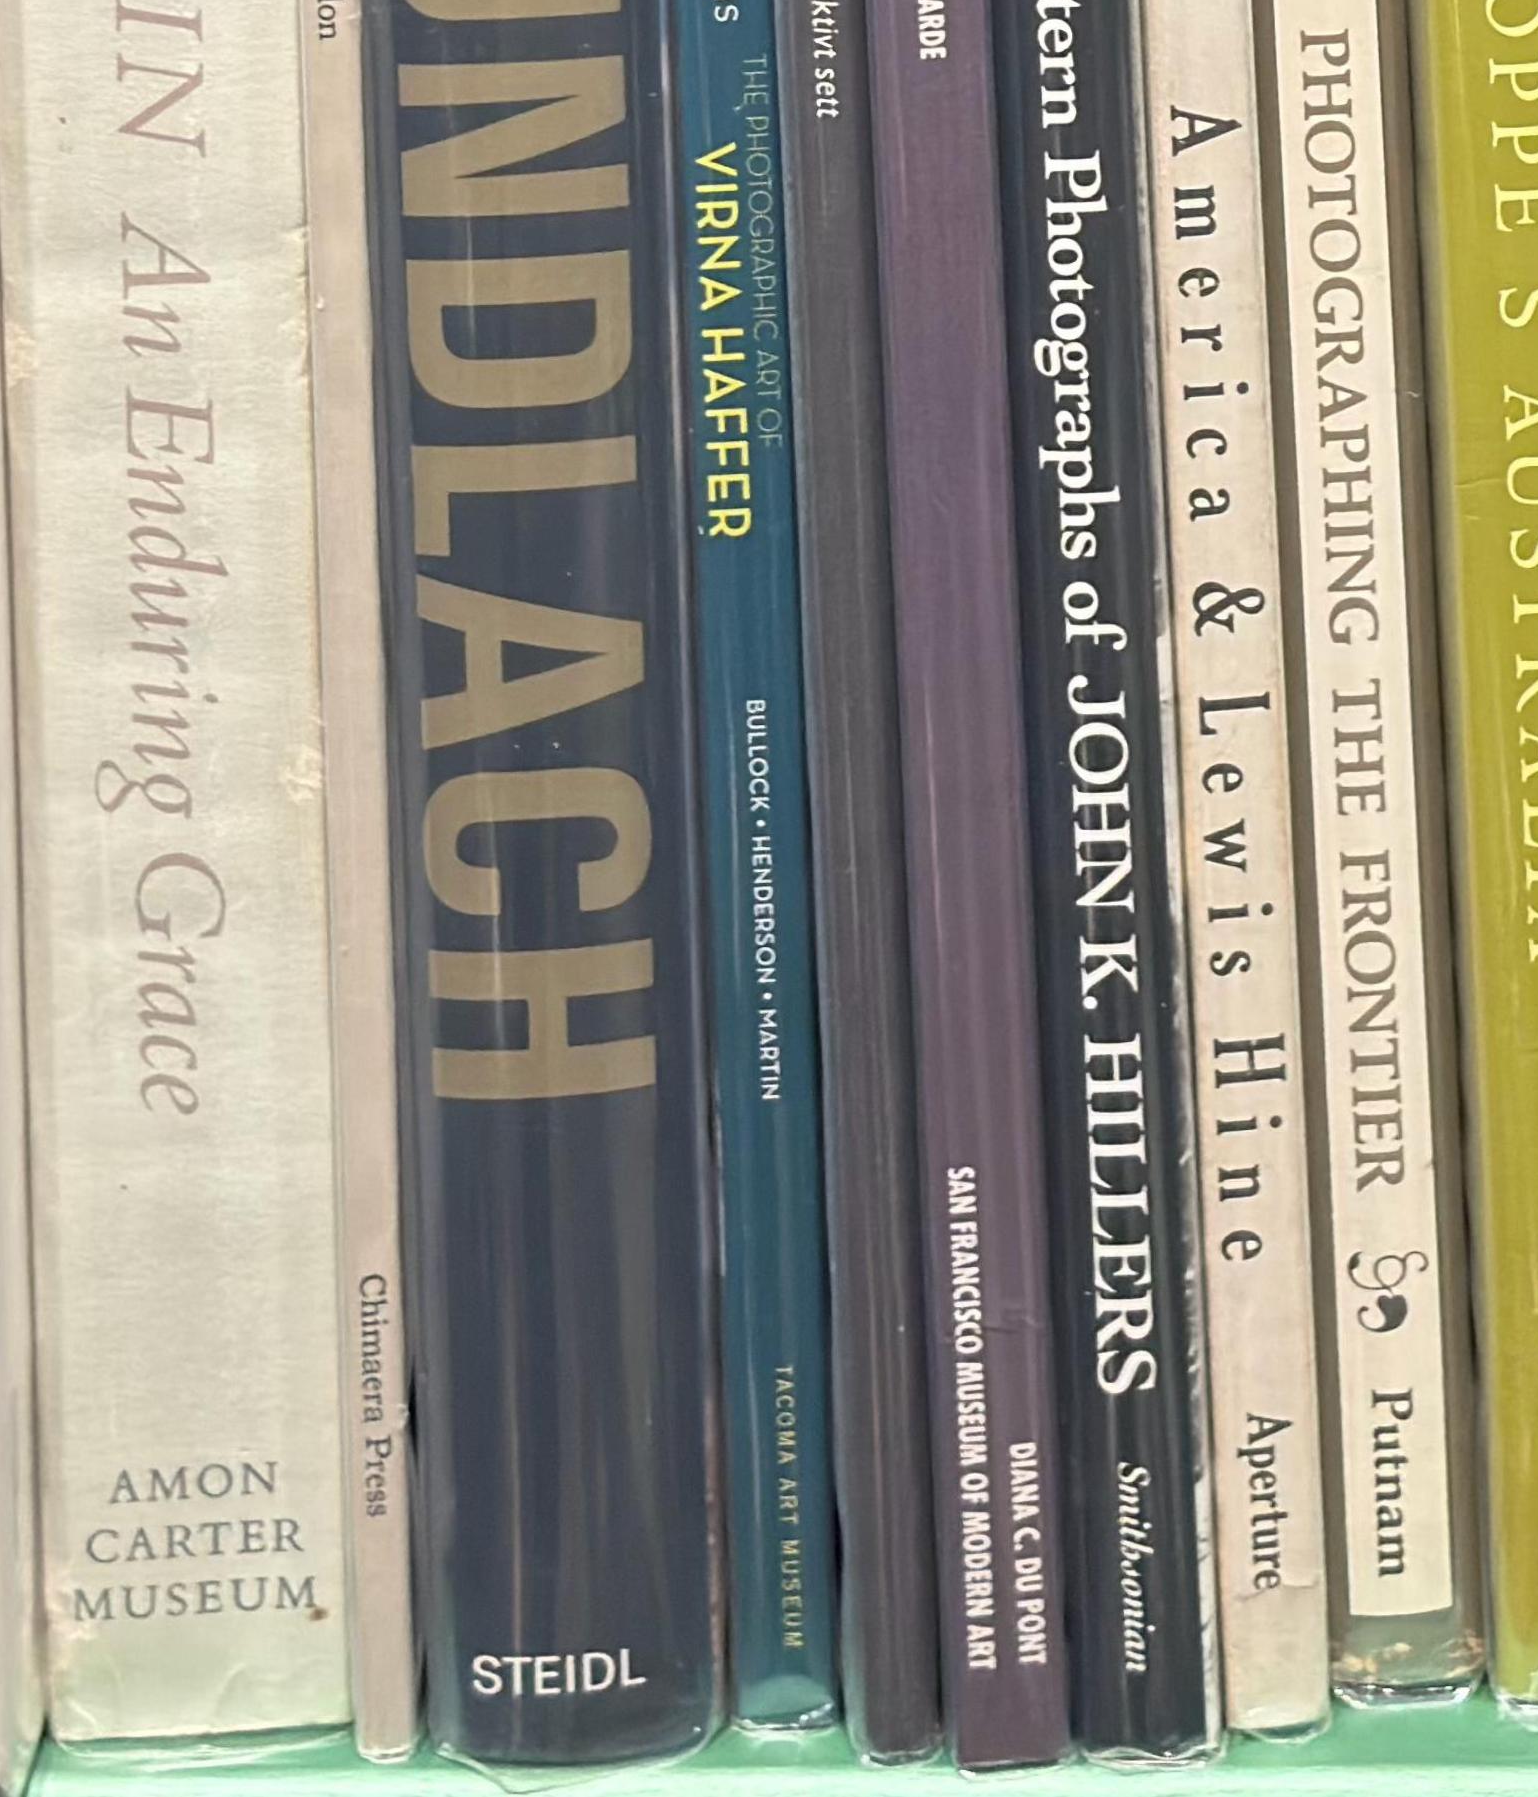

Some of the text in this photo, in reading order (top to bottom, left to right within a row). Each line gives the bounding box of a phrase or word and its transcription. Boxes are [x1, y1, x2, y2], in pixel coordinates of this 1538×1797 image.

[813, 66, 839, 121] sett
[694, 141, 751, 538] VIRNA HAFFER
[743, 53, 782, 448] THE PHOTOGRAPHIC ART OF
[1034, 150, 1120, 559] Photographs
[1300, 29, 1381, 645] PHOTOGRAPHING
[94, 212, 230, 1120] An Enduring Grace
[1062, 581, 1128, 650] of
[1170, 106, 1286, 1262] America & Lewis Hine
[1067, 675, 1134, 909] JOHN
[1332, 678, 1386, 816] THE
[745, 698, 781, 1102] BULLOCK HENDERSON MARTIN
[1078, 934, 1139, 1011] K.
[1340, 849, 1405, 1192] FRONTIER
[1084, 1033, 1159, 1396] HILLERS
[107, 1460, 281, 1504] AMON
[356, 1273, 390, 1516] Chimaera Press
[774, 1363, 803, 1650] TACOMA ART MUSEUM
[948, 1166, 995, 1670] SAN FRANCISCO MUSEUM OF MODERN ART
[1239, 1412, 1290, 1590] Aperture
[1369, 1386, 1413, 1578] Putnam
[72, 1569, 322, 1622] MUSEUM
[84, 1515, 306, 1563] CARTER
[1009, 1443, 1046, 1665] DIANA C. DU PONT
[1116, 1462, 1150, 1674] Smithsonian
[471, 1645, 647, 1696] STEIDL
